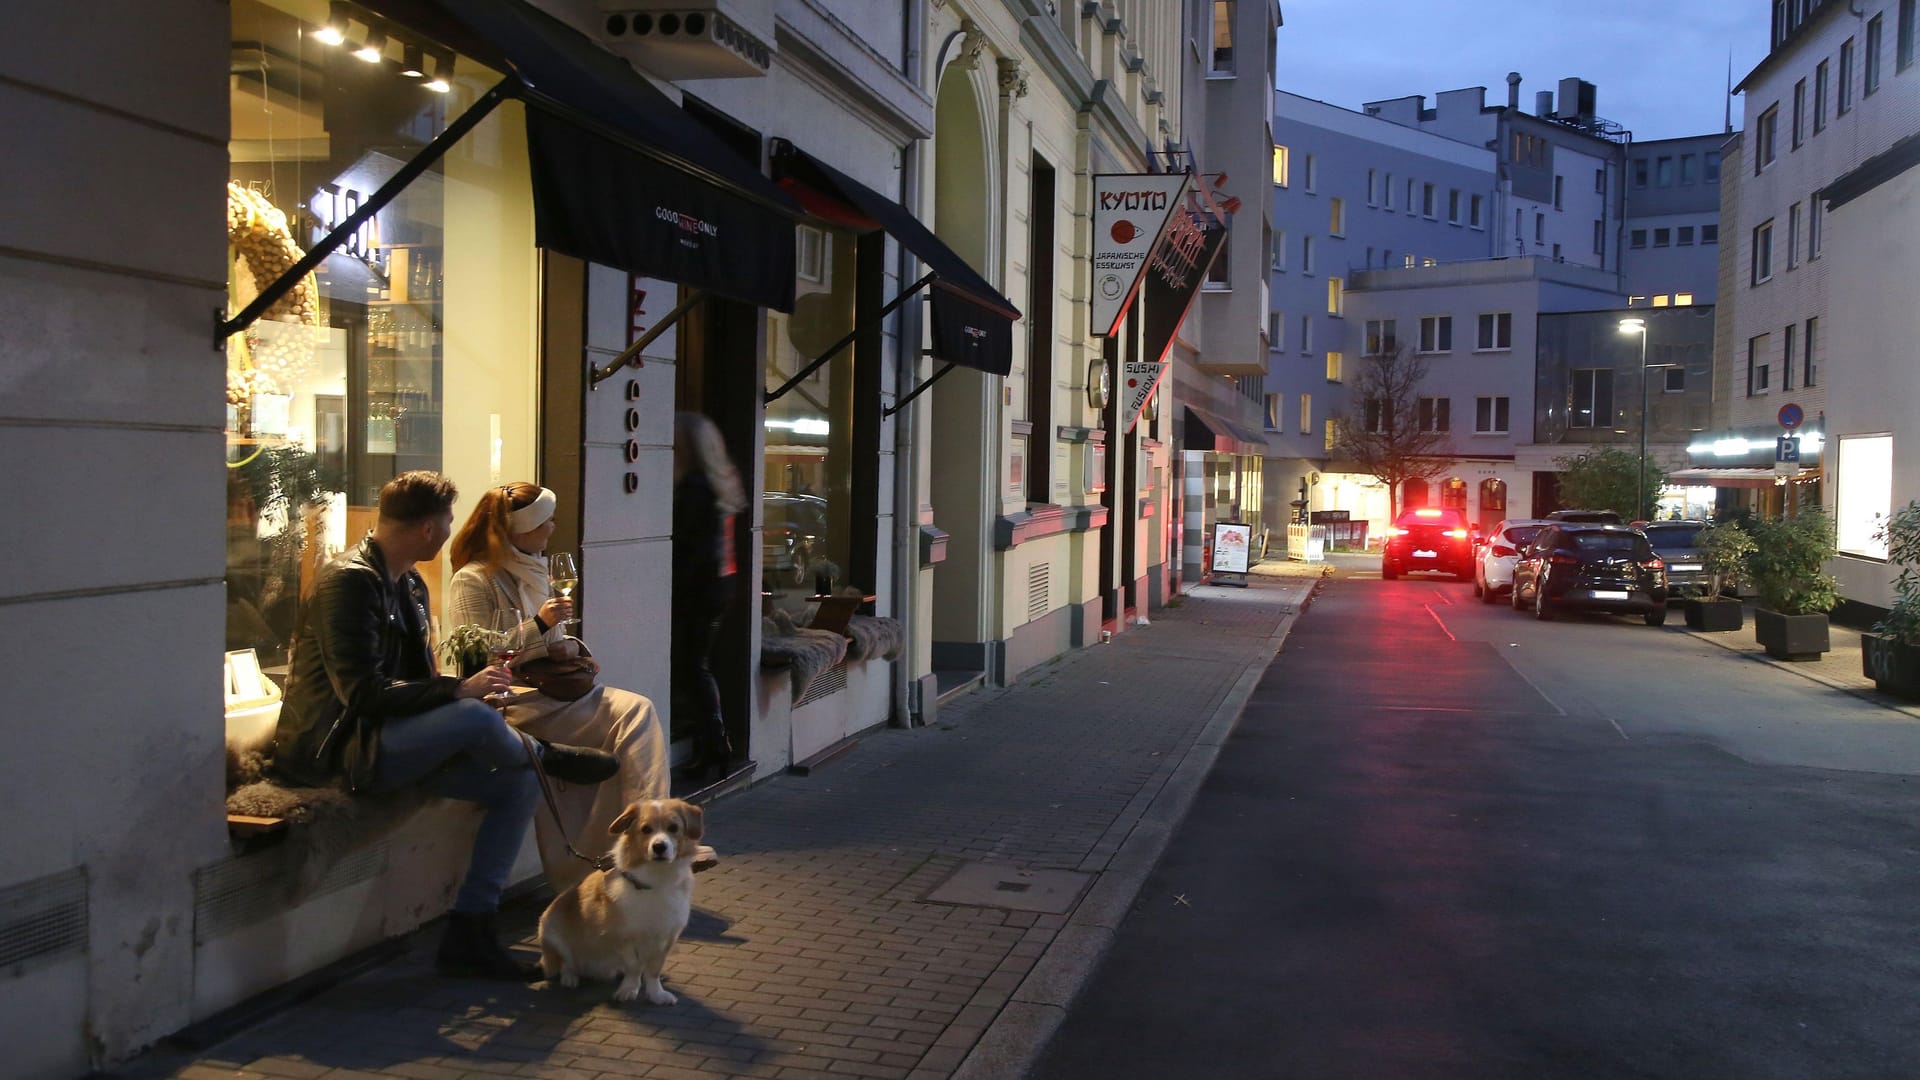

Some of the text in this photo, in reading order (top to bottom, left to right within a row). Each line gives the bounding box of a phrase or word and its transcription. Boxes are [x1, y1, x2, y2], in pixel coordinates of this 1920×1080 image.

[1100, 191, 1167, 211] KYOTO
[698, 220, 718, 237] ONLY
[1096, 252, 1145, 260] JAPANISCHE
[1095, 262, 1135, 270] ESSKUNST
[1126, 363, 1160, 374] SUSHI
[1131, 375, 1156, 410] FUSION
[1781, 440, 1795, 461] P
